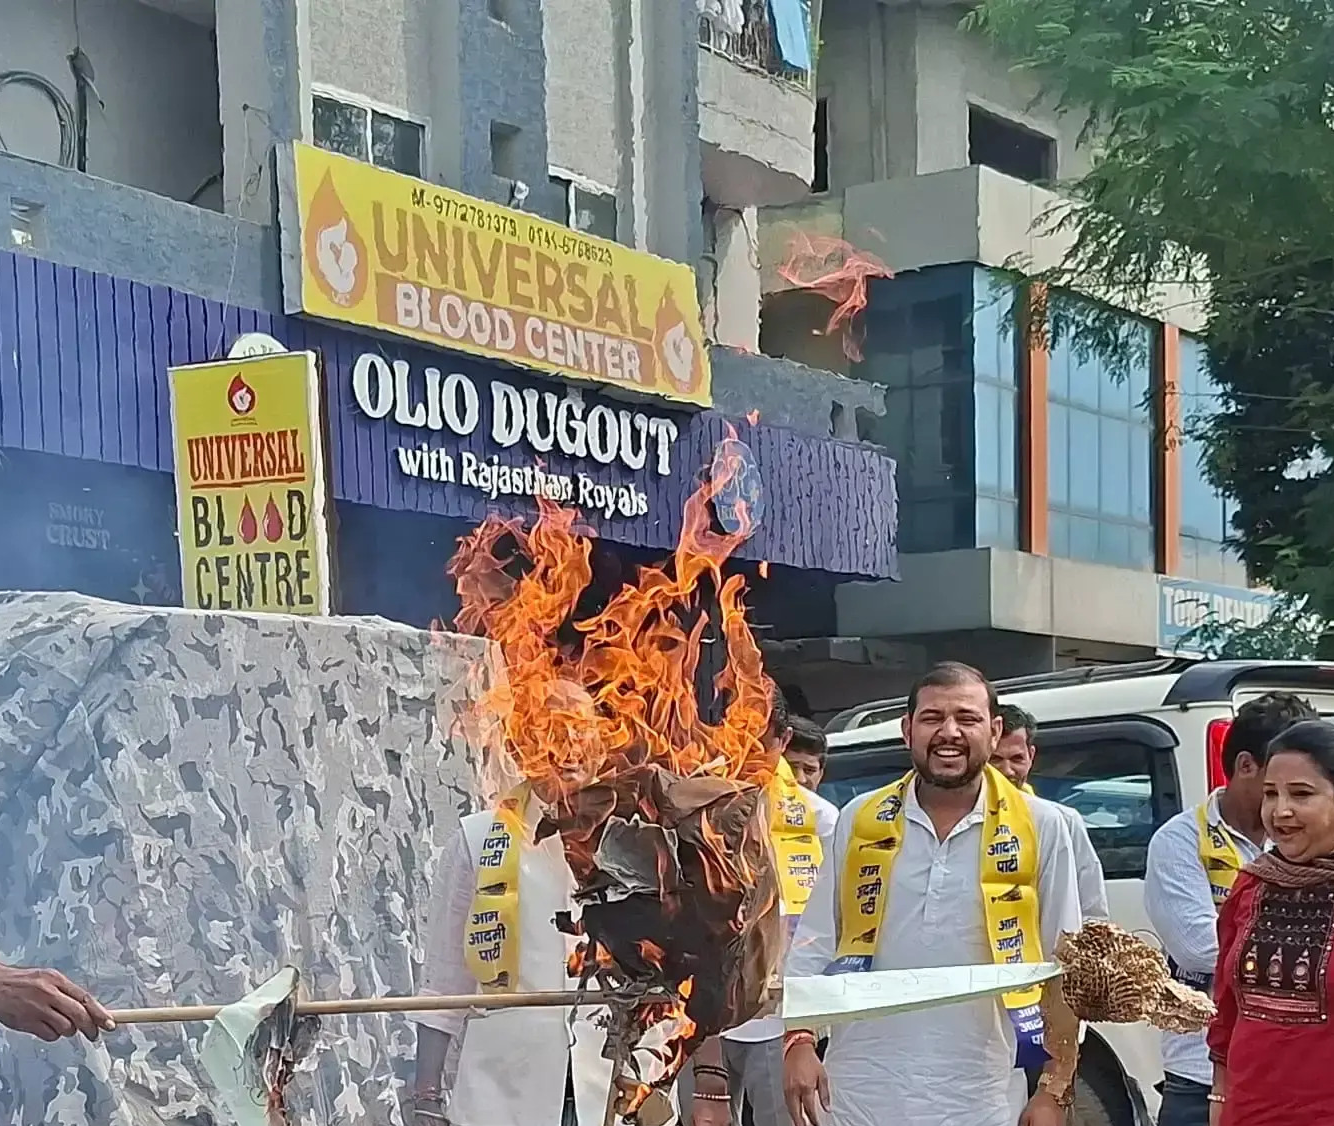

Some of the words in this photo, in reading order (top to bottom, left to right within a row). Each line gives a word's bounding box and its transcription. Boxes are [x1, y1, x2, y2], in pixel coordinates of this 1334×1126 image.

[372, 202, 655, 338] UNIVERSAL
[395, 282, 515, 350] BLOOD
[523, 325, 643, 382] CENTER
[353, 353, 479, 435] OLIO
[492, 379, 679, 476] DUGOUT
[188, 428, 305, 482] UNIVERSAL
[398, 442, 455, 483] with
[461, 451, 573, 502] Rajasthan
[578, 472, 648, 519] Royals
[46, 524, 110, 550] CRUST
[195, 549, 313, 610] CENTRE
[468, 922, 506, 946] आदमी
[472, 910, 499, 926] आम
